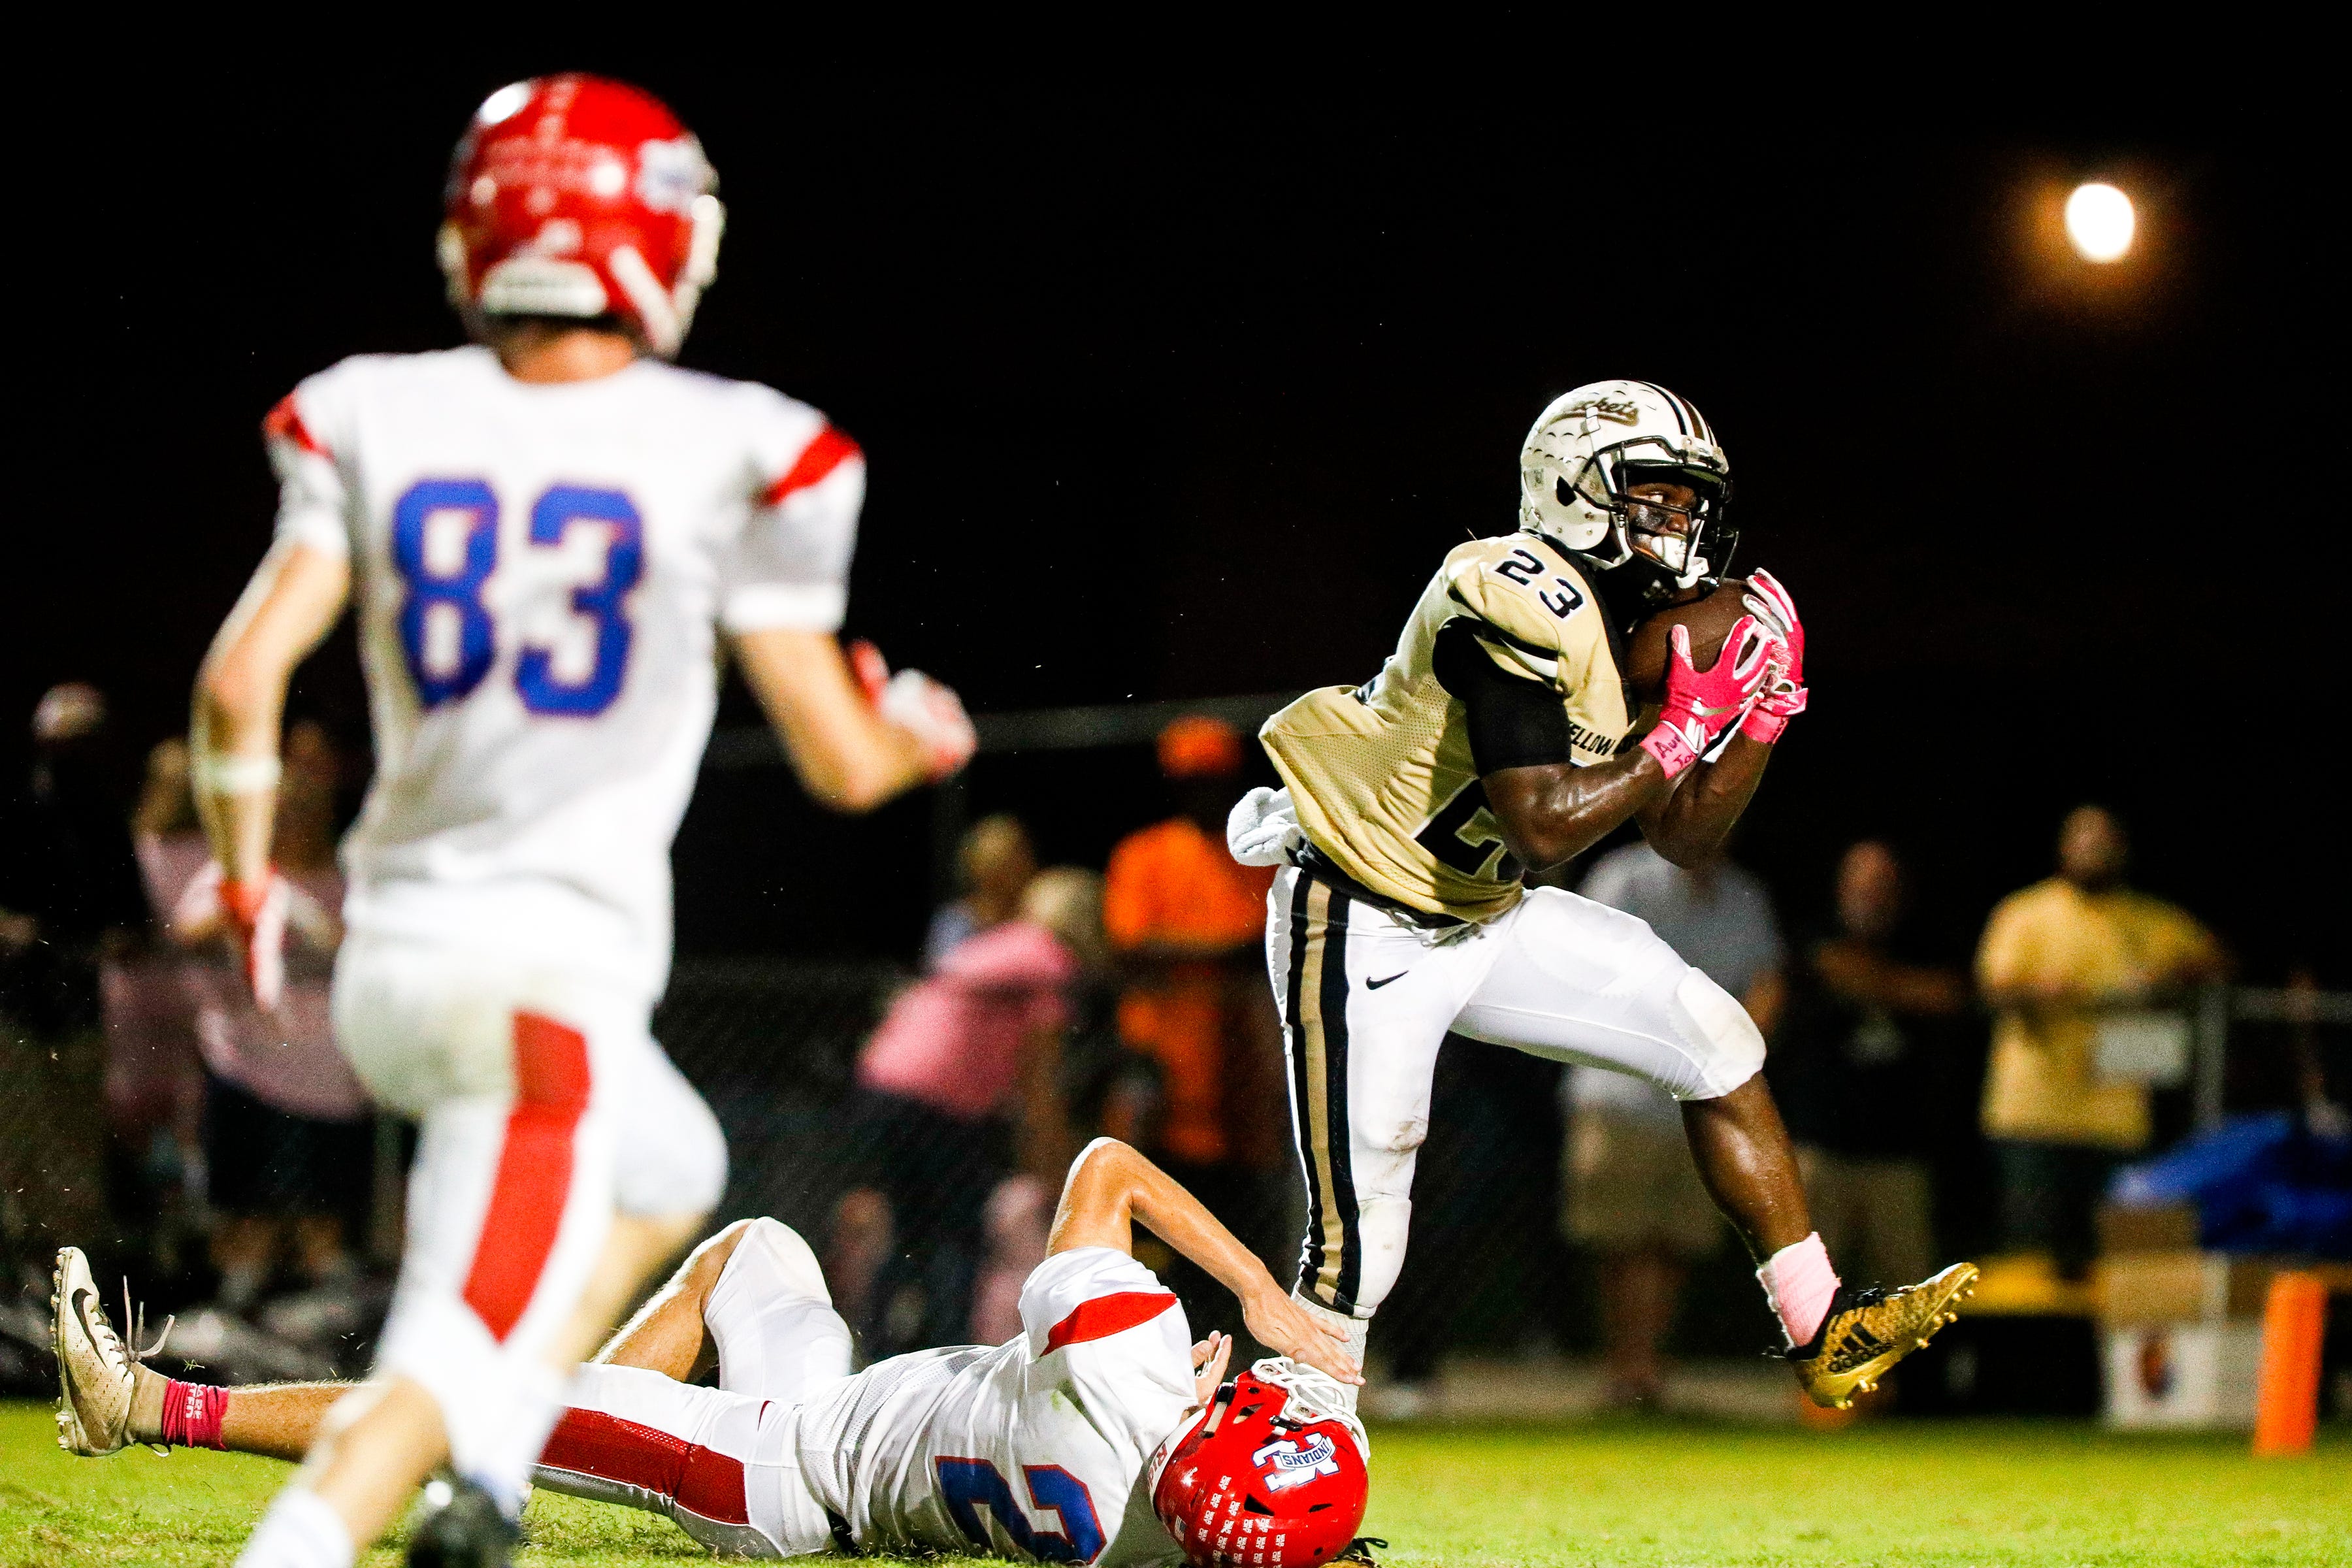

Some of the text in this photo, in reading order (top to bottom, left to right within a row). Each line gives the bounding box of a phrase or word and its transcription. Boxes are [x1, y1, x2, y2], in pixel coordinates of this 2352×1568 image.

[393, 478, 644, 717] 83
[1494, 548, 1586, 620] 23
[1569, 722, 1616, 756] ELLOW
[1282, 1443, 1330, 1465] INDIANS
[935, 1455, 1108, 1567] 2
